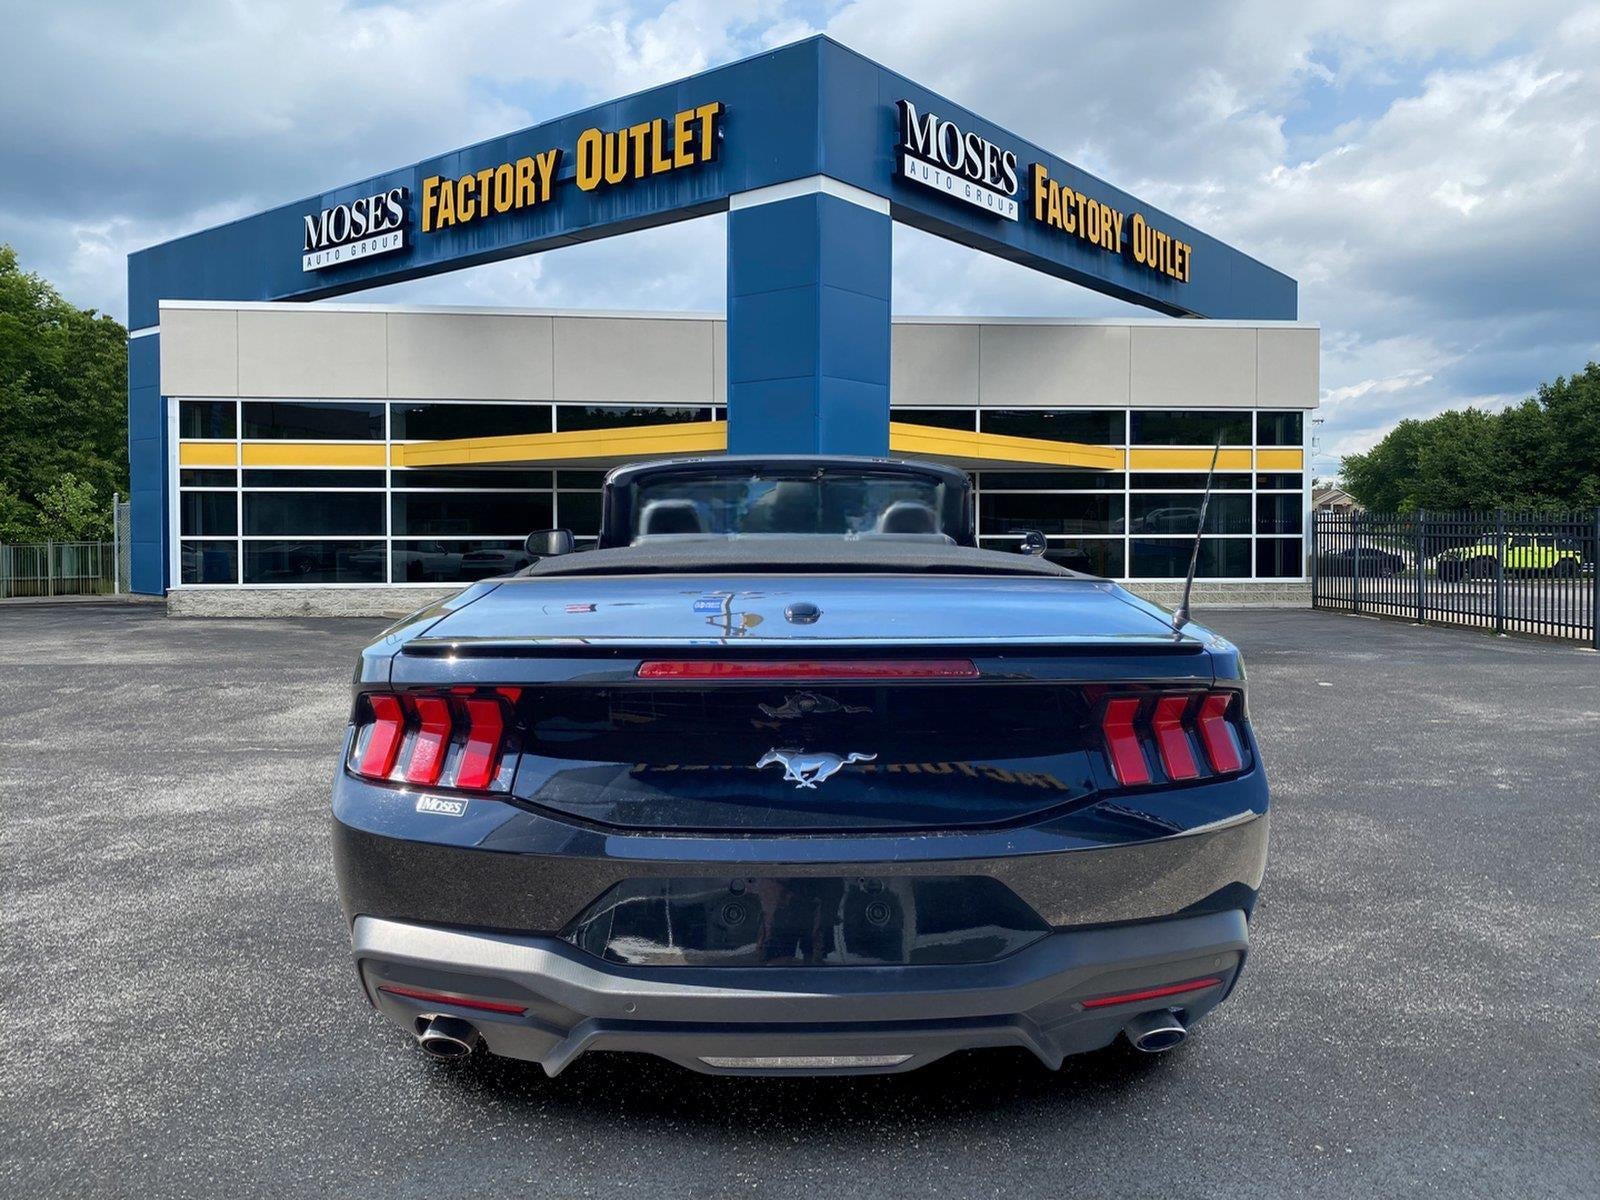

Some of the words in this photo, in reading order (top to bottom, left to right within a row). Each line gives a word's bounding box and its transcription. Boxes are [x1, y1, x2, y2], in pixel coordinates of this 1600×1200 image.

[422, 148, 559, 233] FACTORY
[576, 102, 720, 192] OUTLET
[903, 100, 1018, 196] MOSES
[909, 156, 953, 190] AUTO
[964, 184, 1015, 215] GROUP
[303, 187, 403, 251] MOSES
[307, 249, 340, 268] AUTO
[350, 234, 399, 257] GROUP
[1034, 163, 1124, 253] FACTORY
[1131, 212, 1192, 283] OUTLET
